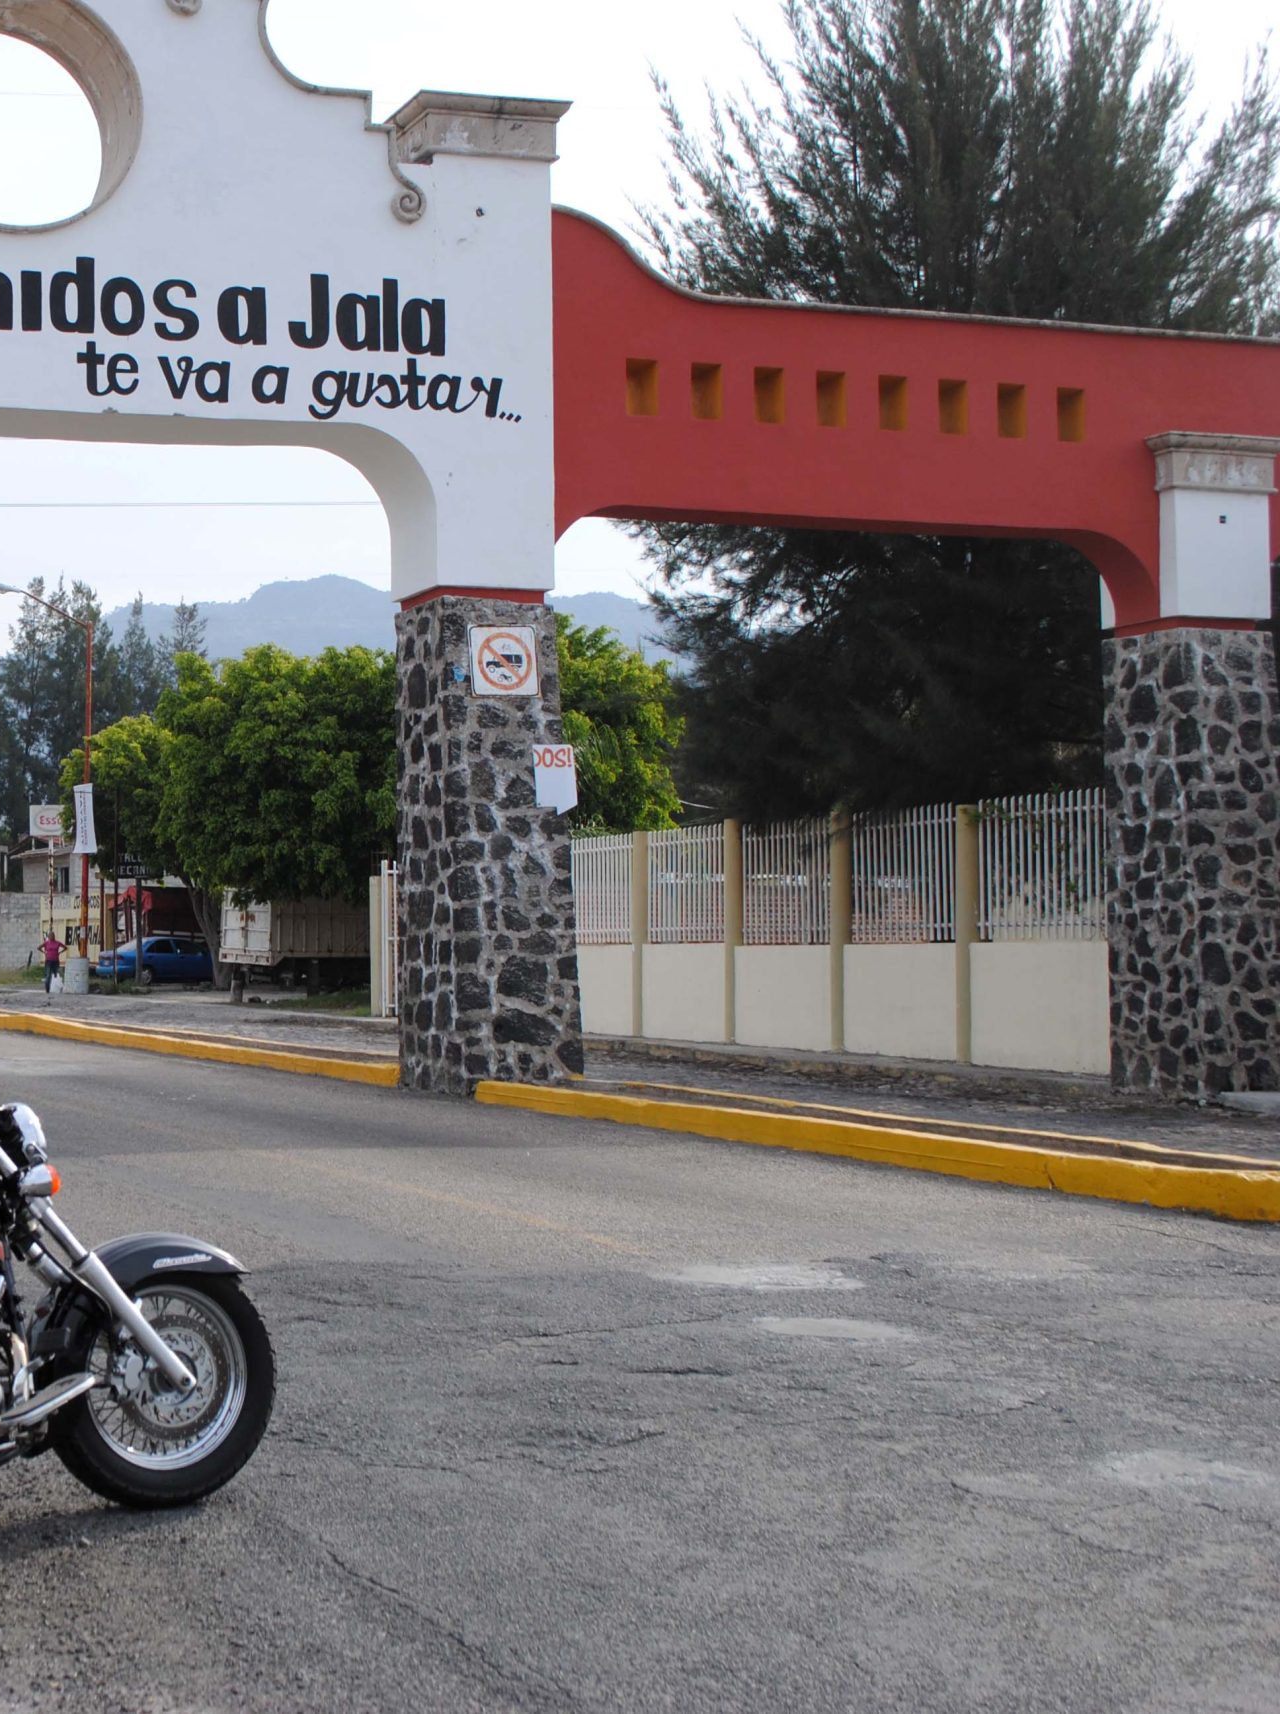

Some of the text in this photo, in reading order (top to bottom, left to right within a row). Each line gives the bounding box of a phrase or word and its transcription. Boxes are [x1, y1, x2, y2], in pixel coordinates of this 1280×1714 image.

[218, 287, 267, 346] a
[288, 274, 446, 357] Jala
[77, 341, 139, 397] te
[158, 357, 231, 404] va
[252, 364, 290, 405] a
